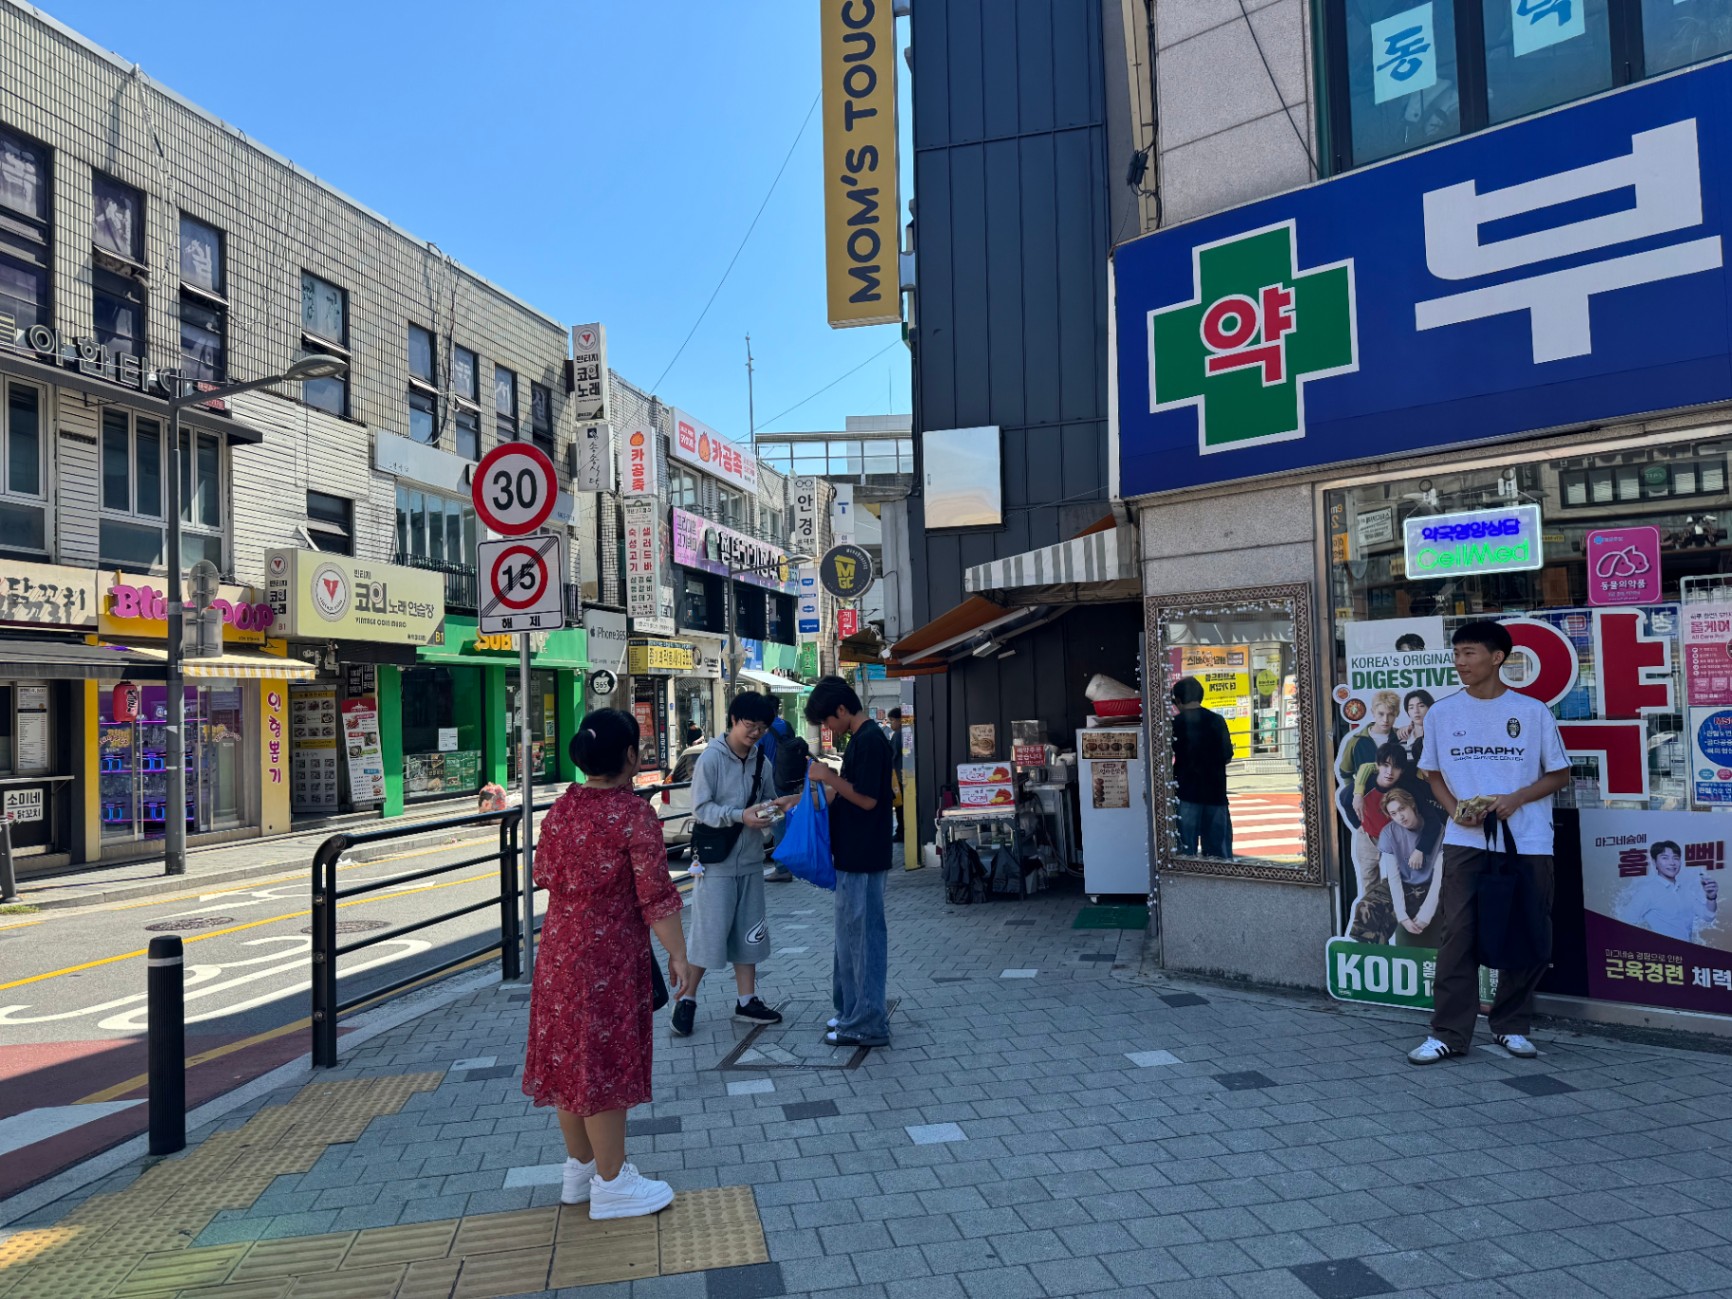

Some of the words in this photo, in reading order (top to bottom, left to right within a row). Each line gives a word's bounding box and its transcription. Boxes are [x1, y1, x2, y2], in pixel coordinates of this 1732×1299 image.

[1377, 25, 1431, 82] 동
[840, 145, 882, 303] MOM'S
[1415, 118, 1723, 364] 부
[1203, 285, 1294, 384] 약
[577, 364, 600, 381] 코인
[577, 382, 600, 397] 노래
[632, 449, 645, 491] 카공족
[712, 438, 743, 479] 카공족
[492, 468, 538, 511] 30
[798, 494, 813, 535] 안경
[837, 502, 849, 514] T
[643, 527, 652, 571] 샐러드바
[1416, 538, 1530, 571] CellMed
[502, 565, 536, 591] 15
[1600, 579, 1646, 591] 동물의약품
[270, 589, 286, 602] 코인
[355, 581, 387, 614] 코인
[389, 599, 407, 615] 노래
[502, 617, 513, 629] 해
[530, 615, 541, 628] 제
[435, 631, 444, 642] B1
[1351, 656, 1399, 669] KOREA's
[595, 681, 608, 689] 365
[1352, 667, 1459, 690] DIGESTIVE
[267, 692, 281, 784] 인형뽑기
[1451, 746, 1525, 756] C.GRAPHY
[7, 791, 41, 805] 소미네
[17, 808, 41, 820] 닭꼬치
[1595, 833, 1647, 848] 마그네슘에
[1605, 949, 1634, 960] 마그네슘
[1667, 954, 1683, 964] 인한
[1336, 952, 1418, 997] KOD
[1605, 958, 1684, 986] 근육경련
